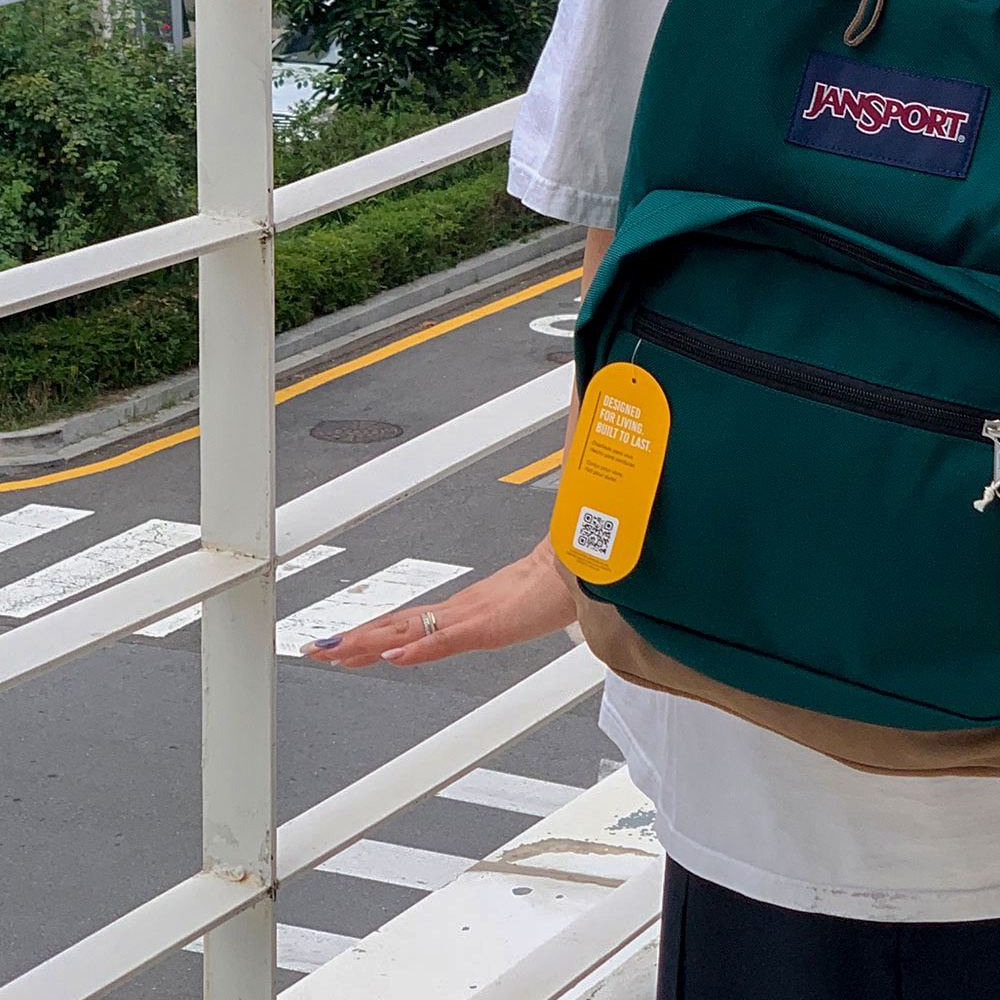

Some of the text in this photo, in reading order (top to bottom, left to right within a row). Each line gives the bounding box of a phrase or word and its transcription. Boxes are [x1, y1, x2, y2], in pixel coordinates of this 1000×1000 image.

[802, 81, 969, 141] JANSPORT
[603, 394, 641, 419] DESIGNED
[599, 408, 644, 435] FOR LIVING.
[595, 422, 619, 439] BUILT
[619, 429, 630, 444] TO
[630, 435, 651, 452] LAST.
